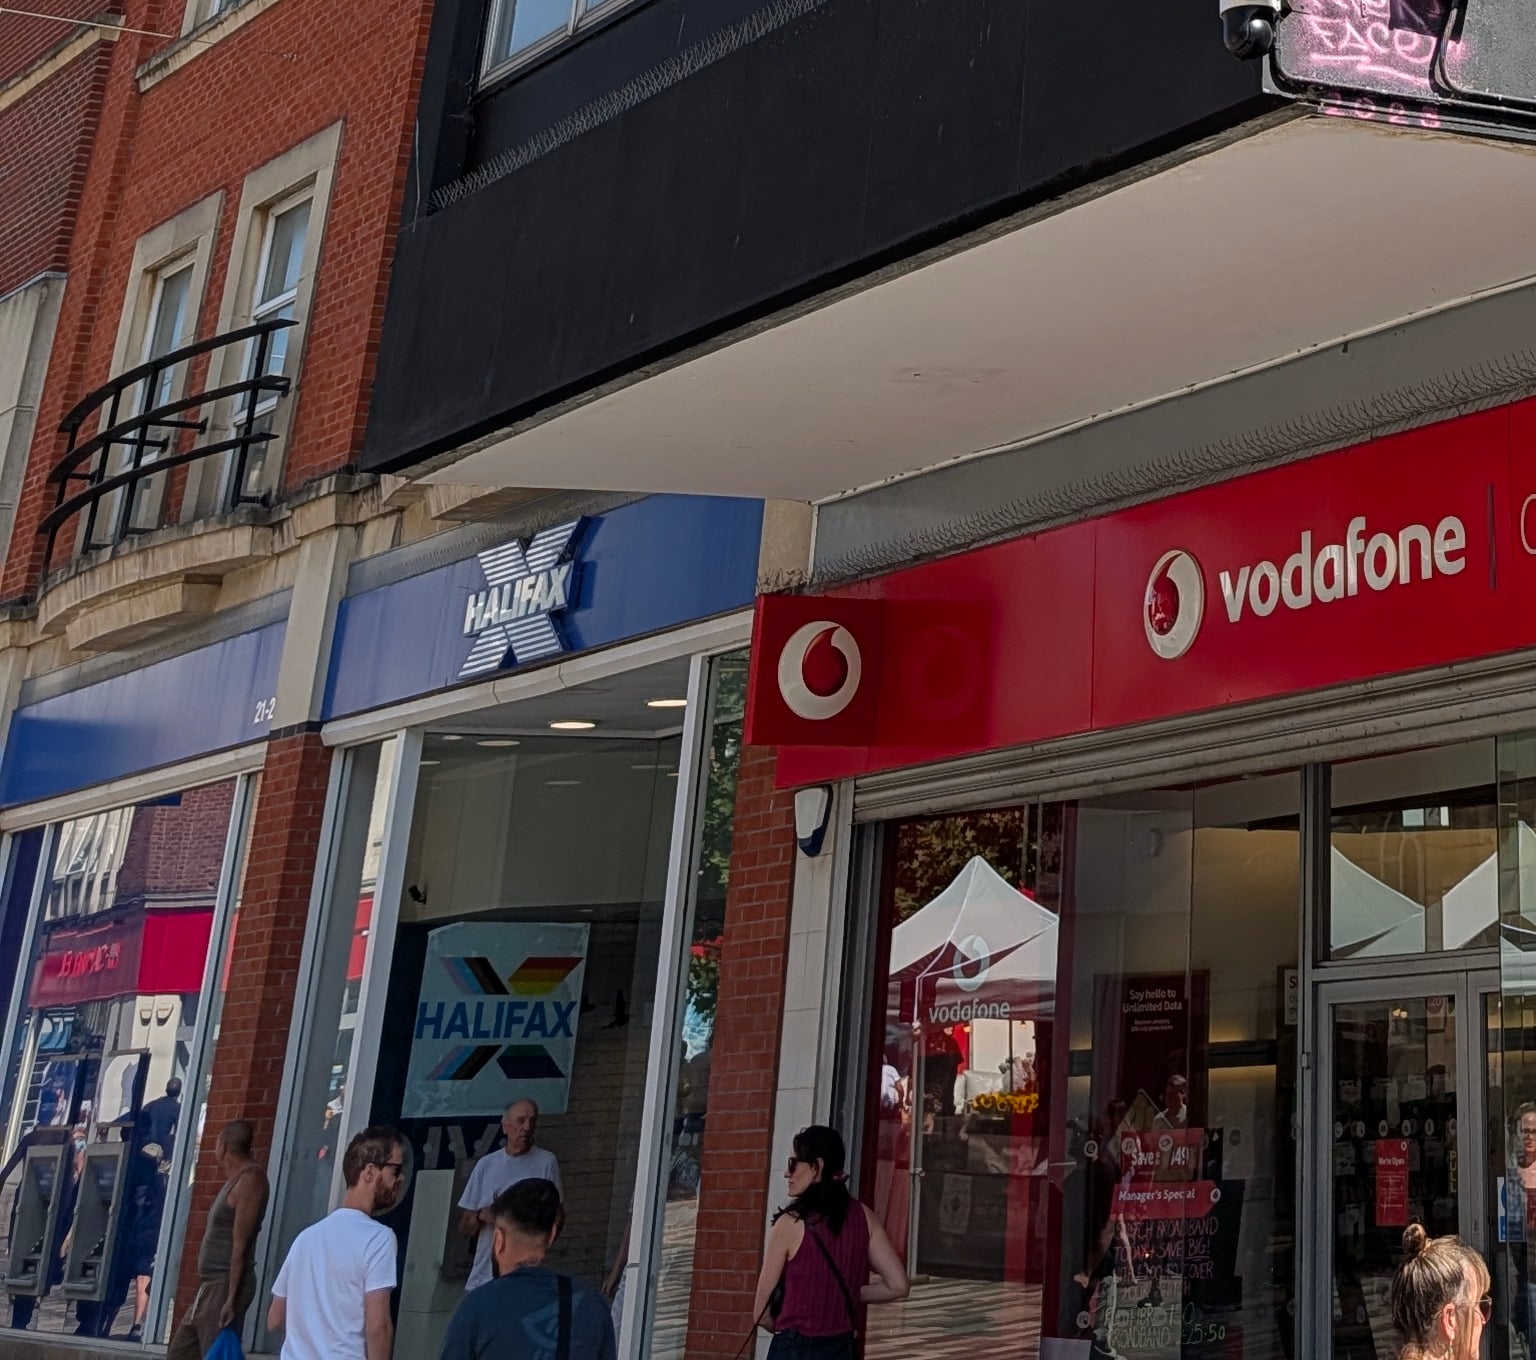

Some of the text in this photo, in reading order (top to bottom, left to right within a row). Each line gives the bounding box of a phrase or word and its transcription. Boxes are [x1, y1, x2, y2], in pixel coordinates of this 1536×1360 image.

[1219, 516, 1467, 623] vodafone
[463, 561, 574, 637] HALIFAX
[1128, 988, 1176, 1002] Say hello to
[928, 998, 1011, 1024] vodafone
[1122, 1000, 1183, 1013] Unlimited Data
[415, 1001, 577, 1040] HALIFAX
[1131, 1148, 1154, 1167] Save
[1118, 1188, 1195, 1203] Manager's Specal
